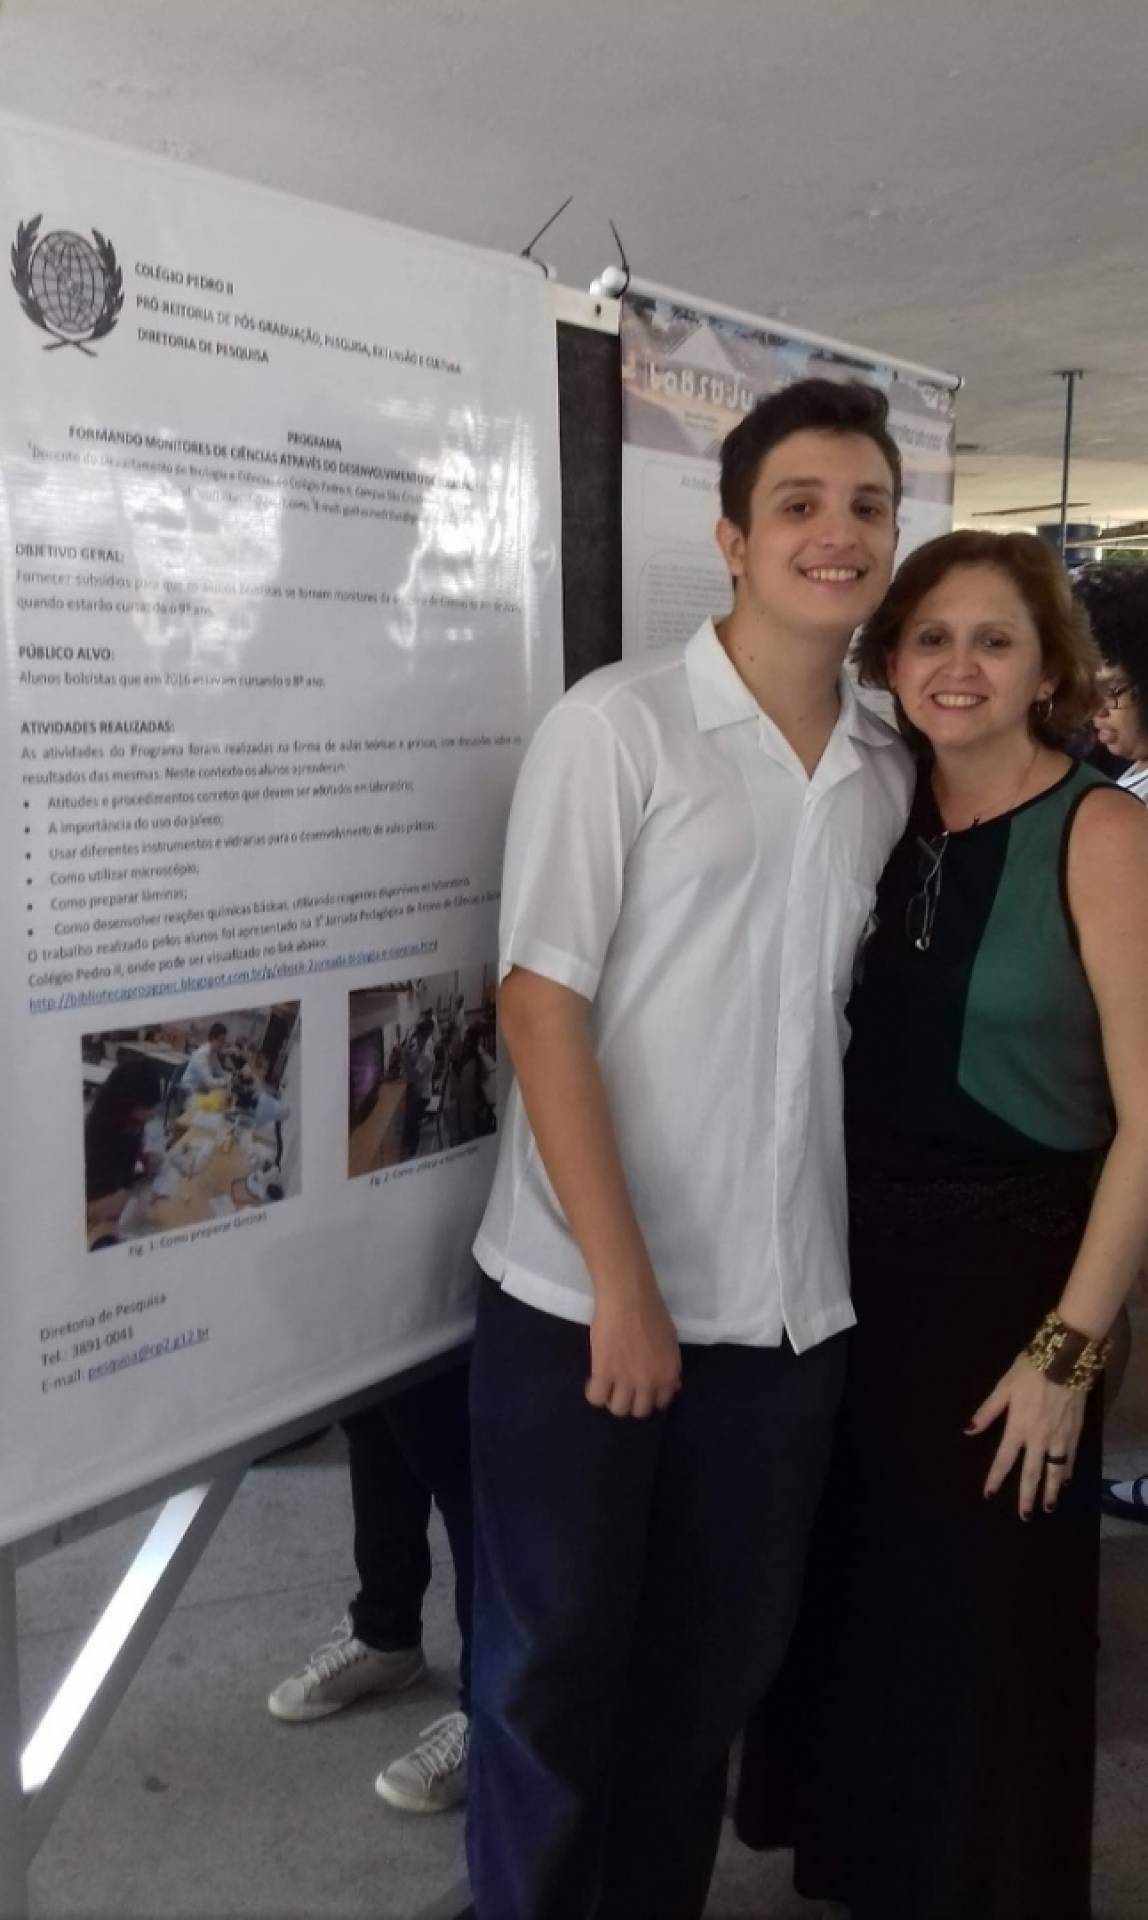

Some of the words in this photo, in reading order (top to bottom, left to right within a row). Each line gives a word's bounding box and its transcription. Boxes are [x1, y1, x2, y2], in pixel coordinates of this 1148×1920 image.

[135, 260, 183, 285] COLÉGIO
[186, 273, 224, 294] PEDRO
[138, 328, 195, 350] DIRETORIA
[216, 341, 269, 363] PESQUISA
[69, 425, 143, 447] FORMANDO
[145, 435, 210, 456] MONITORES
[287, 430, 341, 453] PROGRAMA
[15, 543, 78, 560] OBJETIVO
[16, 595, 64, 611] quando
[19, 644, 73, 660] PÚBLICO
[77, 647, 114, 660] ALVO:
[19, 671, 61, 683] Alunos
[64, 671, 117, 684] bolsistas
[119, 674, 140, 686] que
[21, 720, 96, 733] ATIVIDADES
[130, 742, 183, 757] Programa
[22, 769, 86, 784] resultados
[89, 769, 109, 782] das
[165, 766, 196, 779] Neste
[48, 794, 98, 810] Atitudes
[60, 817, 131, 836] importância
[151, 817, 171, 828] uso
[49, 846, 76, 860] Usar
[80, 841, 140, 858] diferentes
[51, 869, 86, 885] Como
[88, 865, 128, 881] utilizar
[51, 894, 87, 910] Como
[90, 892, 138, 908] preparar
[54, 920, 90, 936] Como
[93, 912, 160, 931] desenvolver
[41, 942, 93, 961] trabalho
[96, 934, 148, 954] realizado
[28, 969, 73, 991] Colégio
[76, 964, 111, 981] Pedro
[127, 957, 155, 973] onde
[158, 953, 186, 971] pode
[40, 1312, 95, 1341] Diretoria
[115, 1291, 166, 1321] Pesquisa
